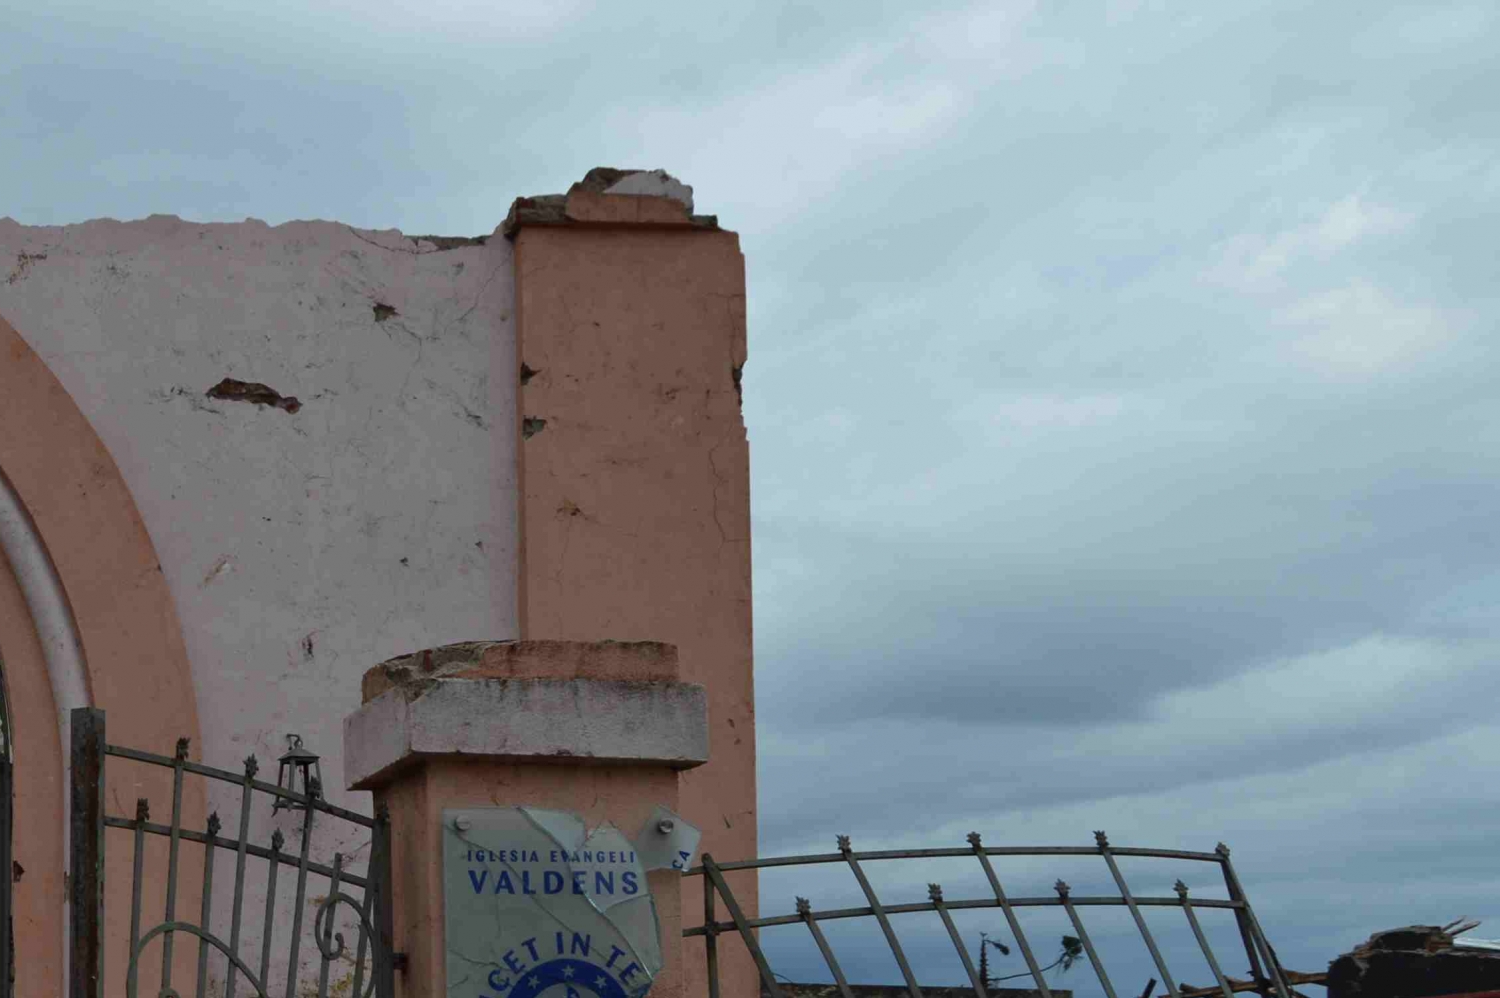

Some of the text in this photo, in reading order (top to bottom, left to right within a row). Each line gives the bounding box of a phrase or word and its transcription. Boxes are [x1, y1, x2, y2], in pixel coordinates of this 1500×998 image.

[467, 850, 539, 862] IGLESIA
[467, 870, 639, 895] VALDENS
[556, 932, 591, 957] IN
